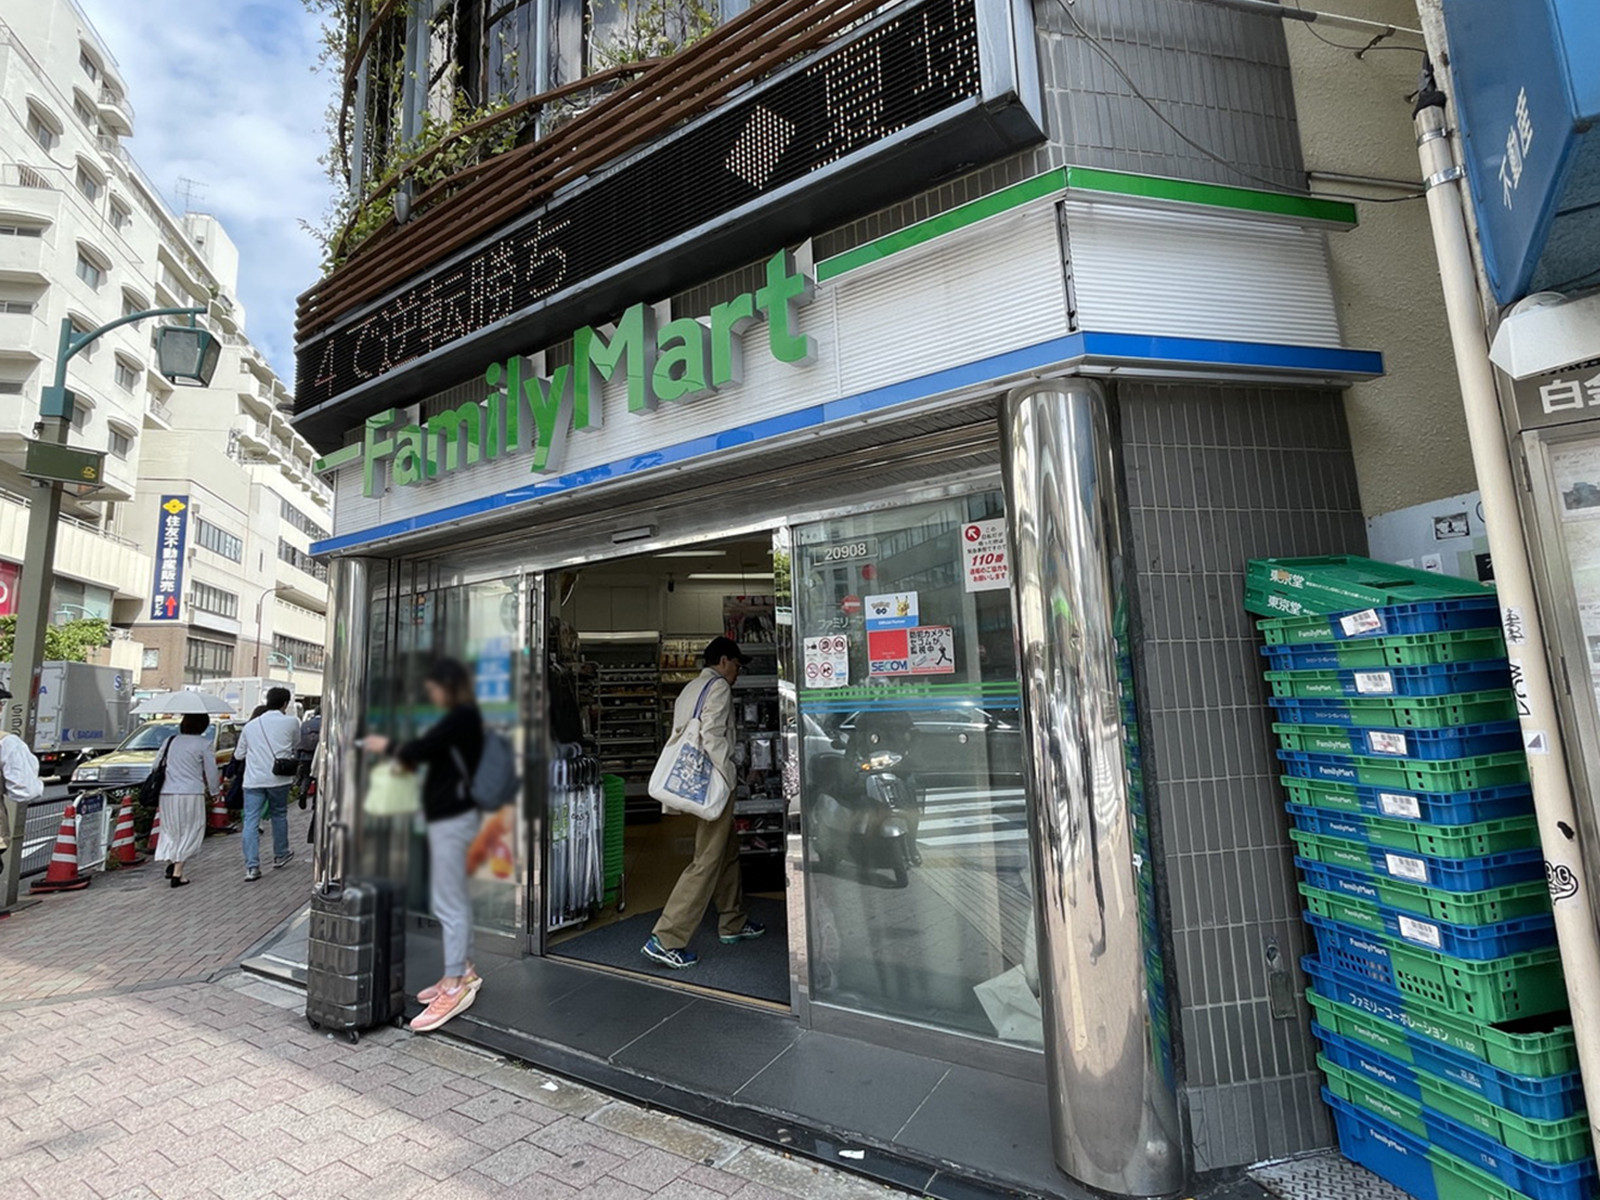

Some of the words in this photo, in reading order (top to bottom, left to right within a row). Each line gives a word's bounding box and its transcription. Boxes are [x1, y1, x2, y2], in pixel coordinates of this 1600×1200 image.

[363, 247, 814, 498] FamilyMart
[160, 515, 181, 592] 住友不動産販売
[824, 543, 867, 561] 20908
[1298, 628, 1332, 639] FamilyMart
[871, 660, 908, 672] SECOM
[1316, 739, 1351, 750] FamilyMart
[1319, 766, 1355, 777] FamilyMart
[1339, 880, 1376, 896] FamilyMart
[1349, 937, 1387, 956] FamilyMart
[1348, 992, 1449, 1041] ファミリーコーポレーション
[1353, 1024, 1390, 1045] FamilyMart
[1360, 1060, 1397, 1083] FamilyMart
[1365, 1094, 1402, 1119] FamilyMart
[1370, 1129, 1408, 1155] FamilyMart
